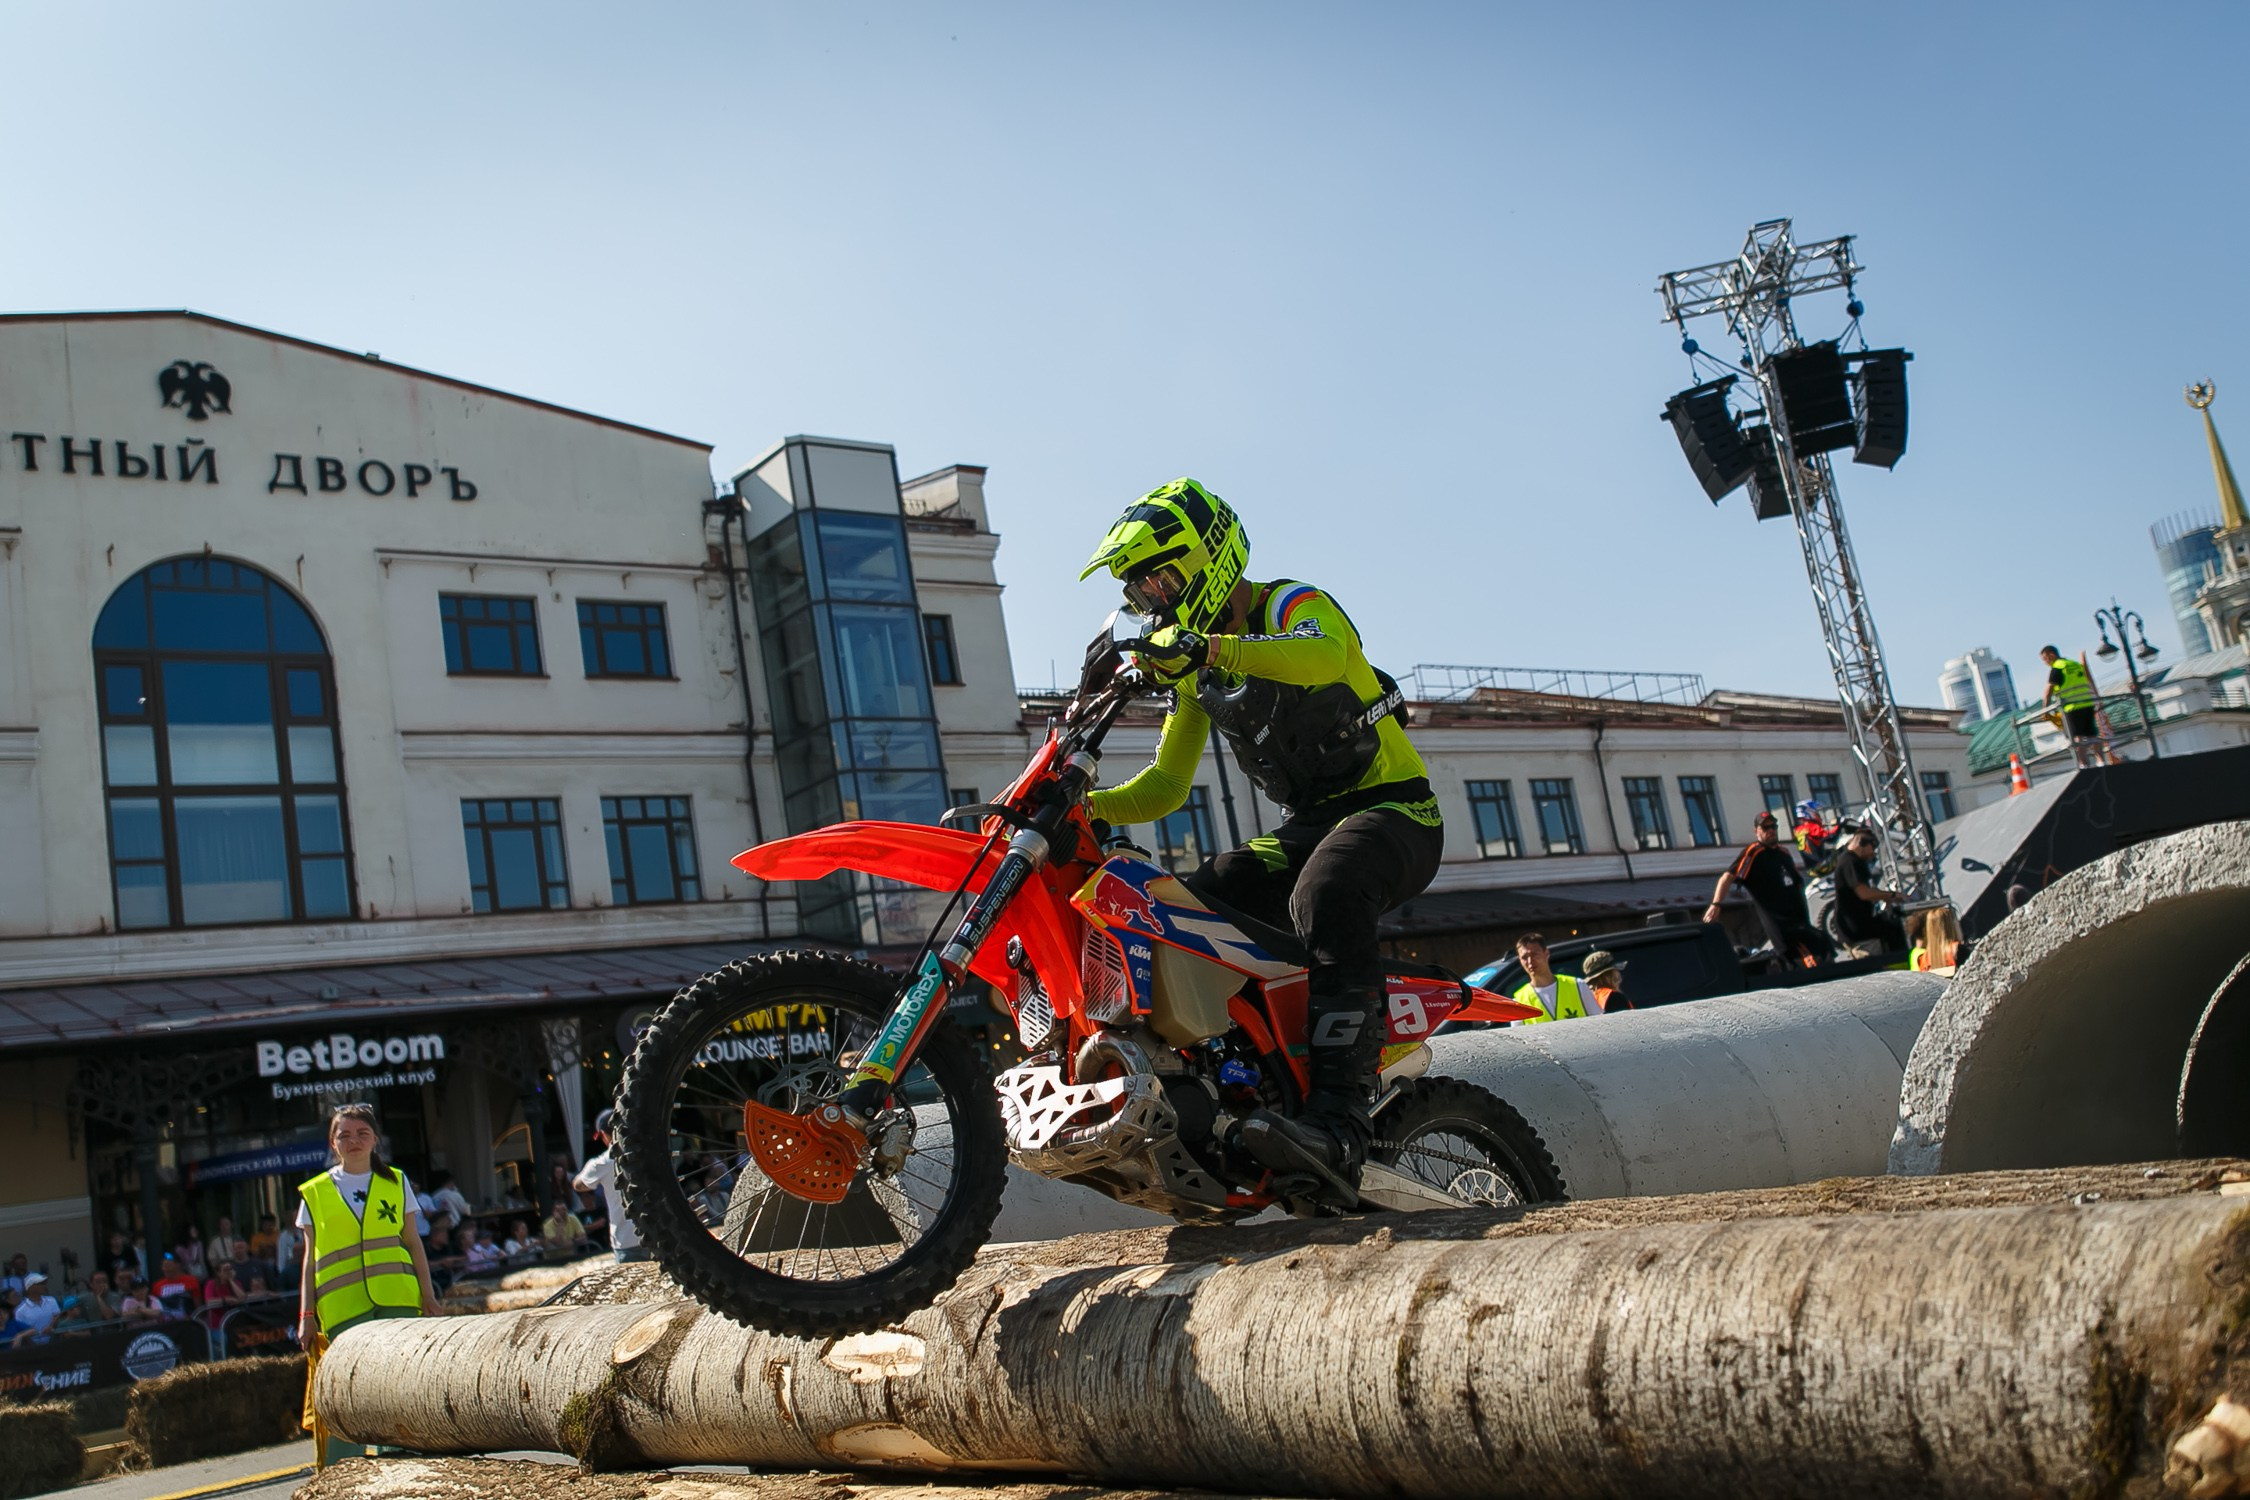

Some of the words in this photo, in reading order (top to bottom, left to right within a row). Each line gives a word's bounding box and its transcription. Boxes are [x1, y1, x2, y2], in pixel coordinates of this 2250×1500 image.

[268, 454, 478, 501] ДВОРЪ
[969, 860, 1024, 944] SUSPENSION
[1129, 944, 1151, 960] KTM
[888, 972, 938, 1043] MOTOREX
[1388, 993, 1428, 1034] 9
[790, 1033, 831, 1055] BAR
[1312, 1011, 1366, 1046] G
[256, 1033, 445, 1077] BetBoom
[272, 1073, 394, 1100] Букмекерский
[399, 1067, 436, 1087] клуб
